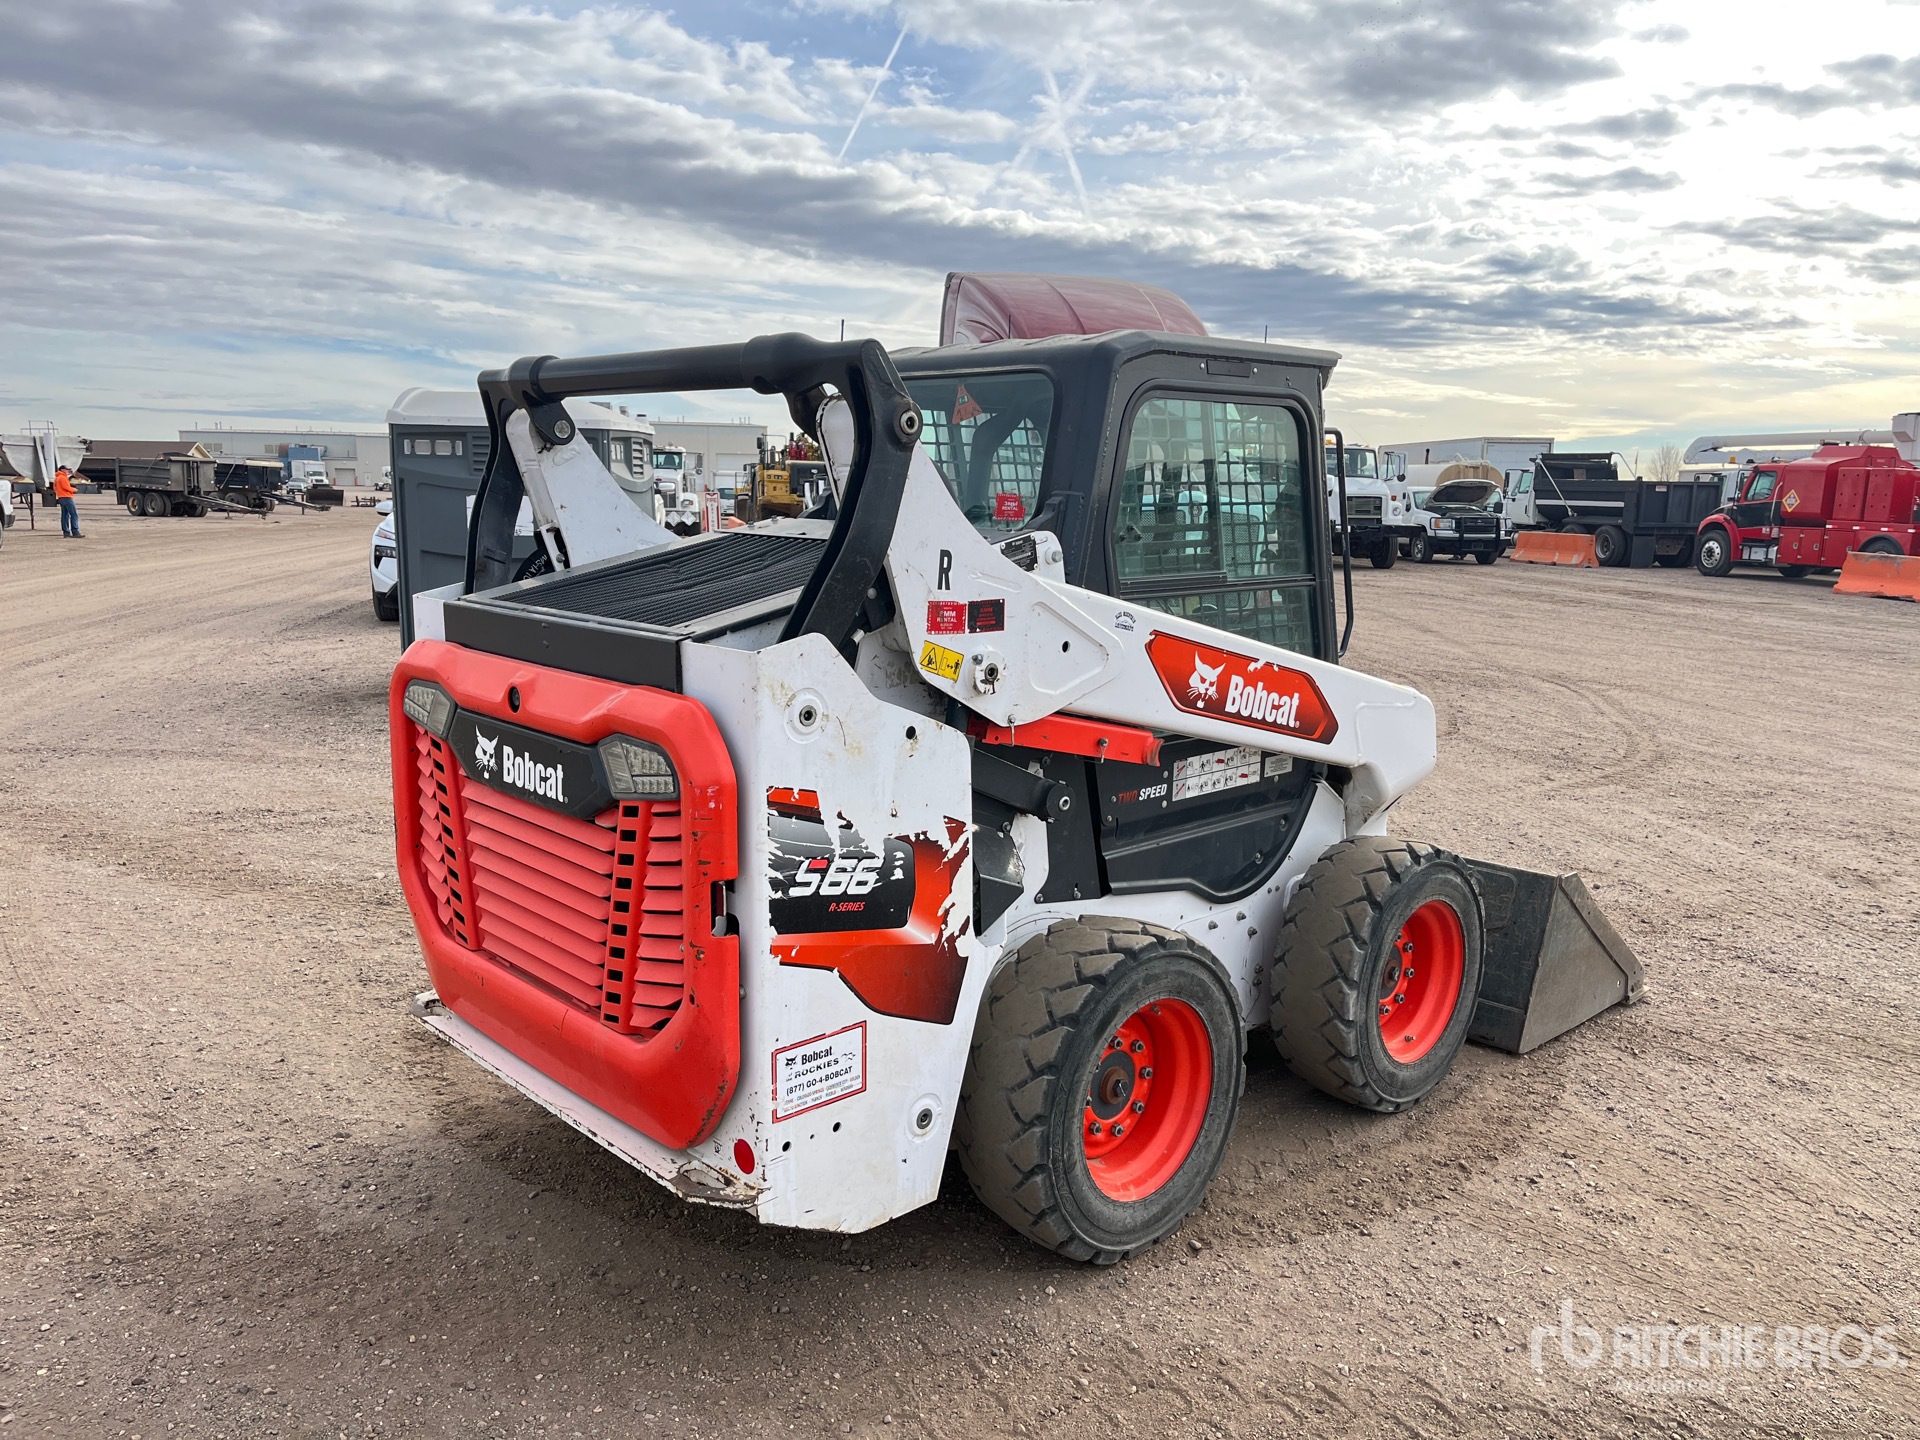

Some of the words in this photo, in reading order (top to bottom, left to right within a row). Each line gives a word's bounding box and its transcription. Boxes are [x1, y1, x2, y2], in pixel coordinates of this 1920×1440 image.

[937, 549, 952, 590] R
[1225, 674, 1299, 729] Bobcat
[502, 745, 564, 803] Bobcat
[1118, 790, 1139, 804] TWO
[1138, 783, 1168, 801] SPEED
[789, 858, 884, 896] S66
[828, 902, 866, 912] R-SERIES
[794, 1057, 840, 1079] ROCKIES
[801, 1046, 833, 1065] Bobcat
[786, 1081, 805, 1097] (877)
[806, 1066, 853, 1089] GO-4-BOBCAT
